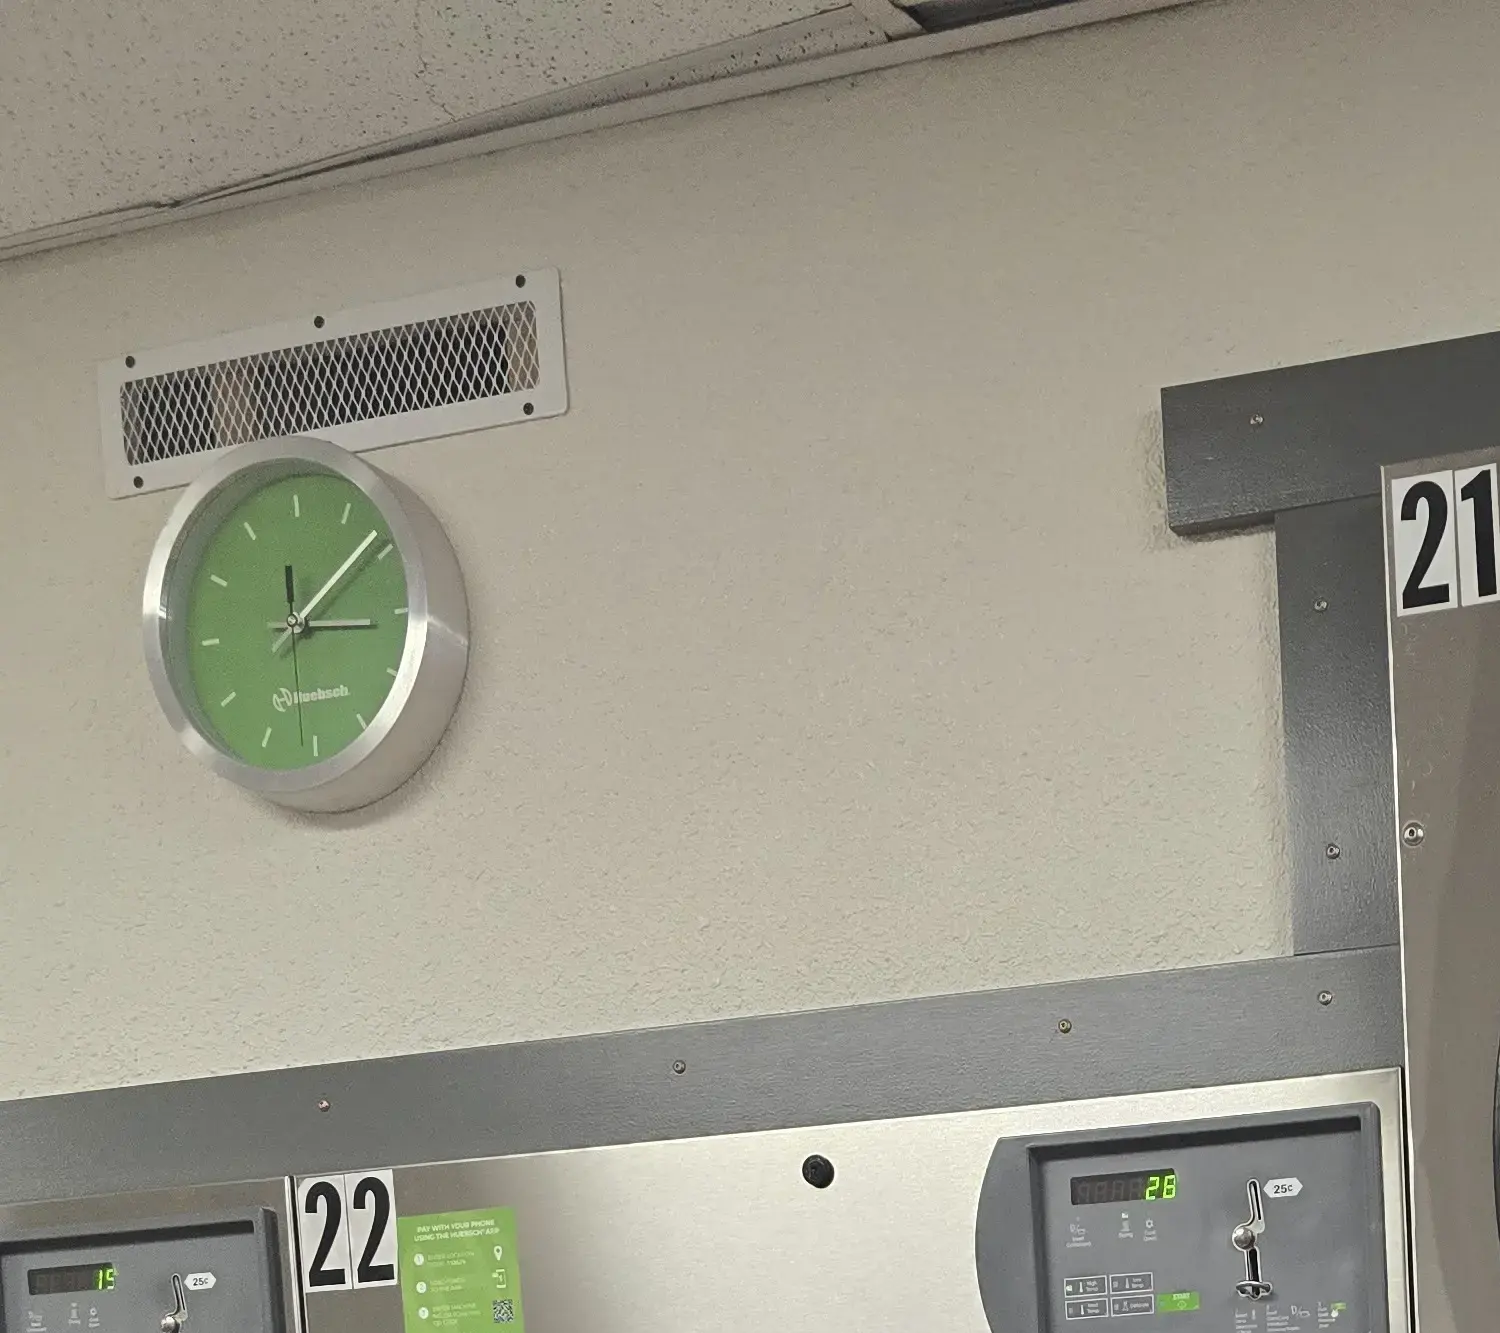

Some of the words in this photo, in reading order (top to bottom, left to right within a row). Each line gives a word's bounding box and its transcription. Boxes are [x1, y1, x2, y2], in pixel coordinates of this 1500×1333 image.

[1400, 468, 1497, 609] 21
[293, 684, 349, 703] Huebsch
[304, 1176, 395, 1287] 22
[431, 1223, 450, 1231] WITH
